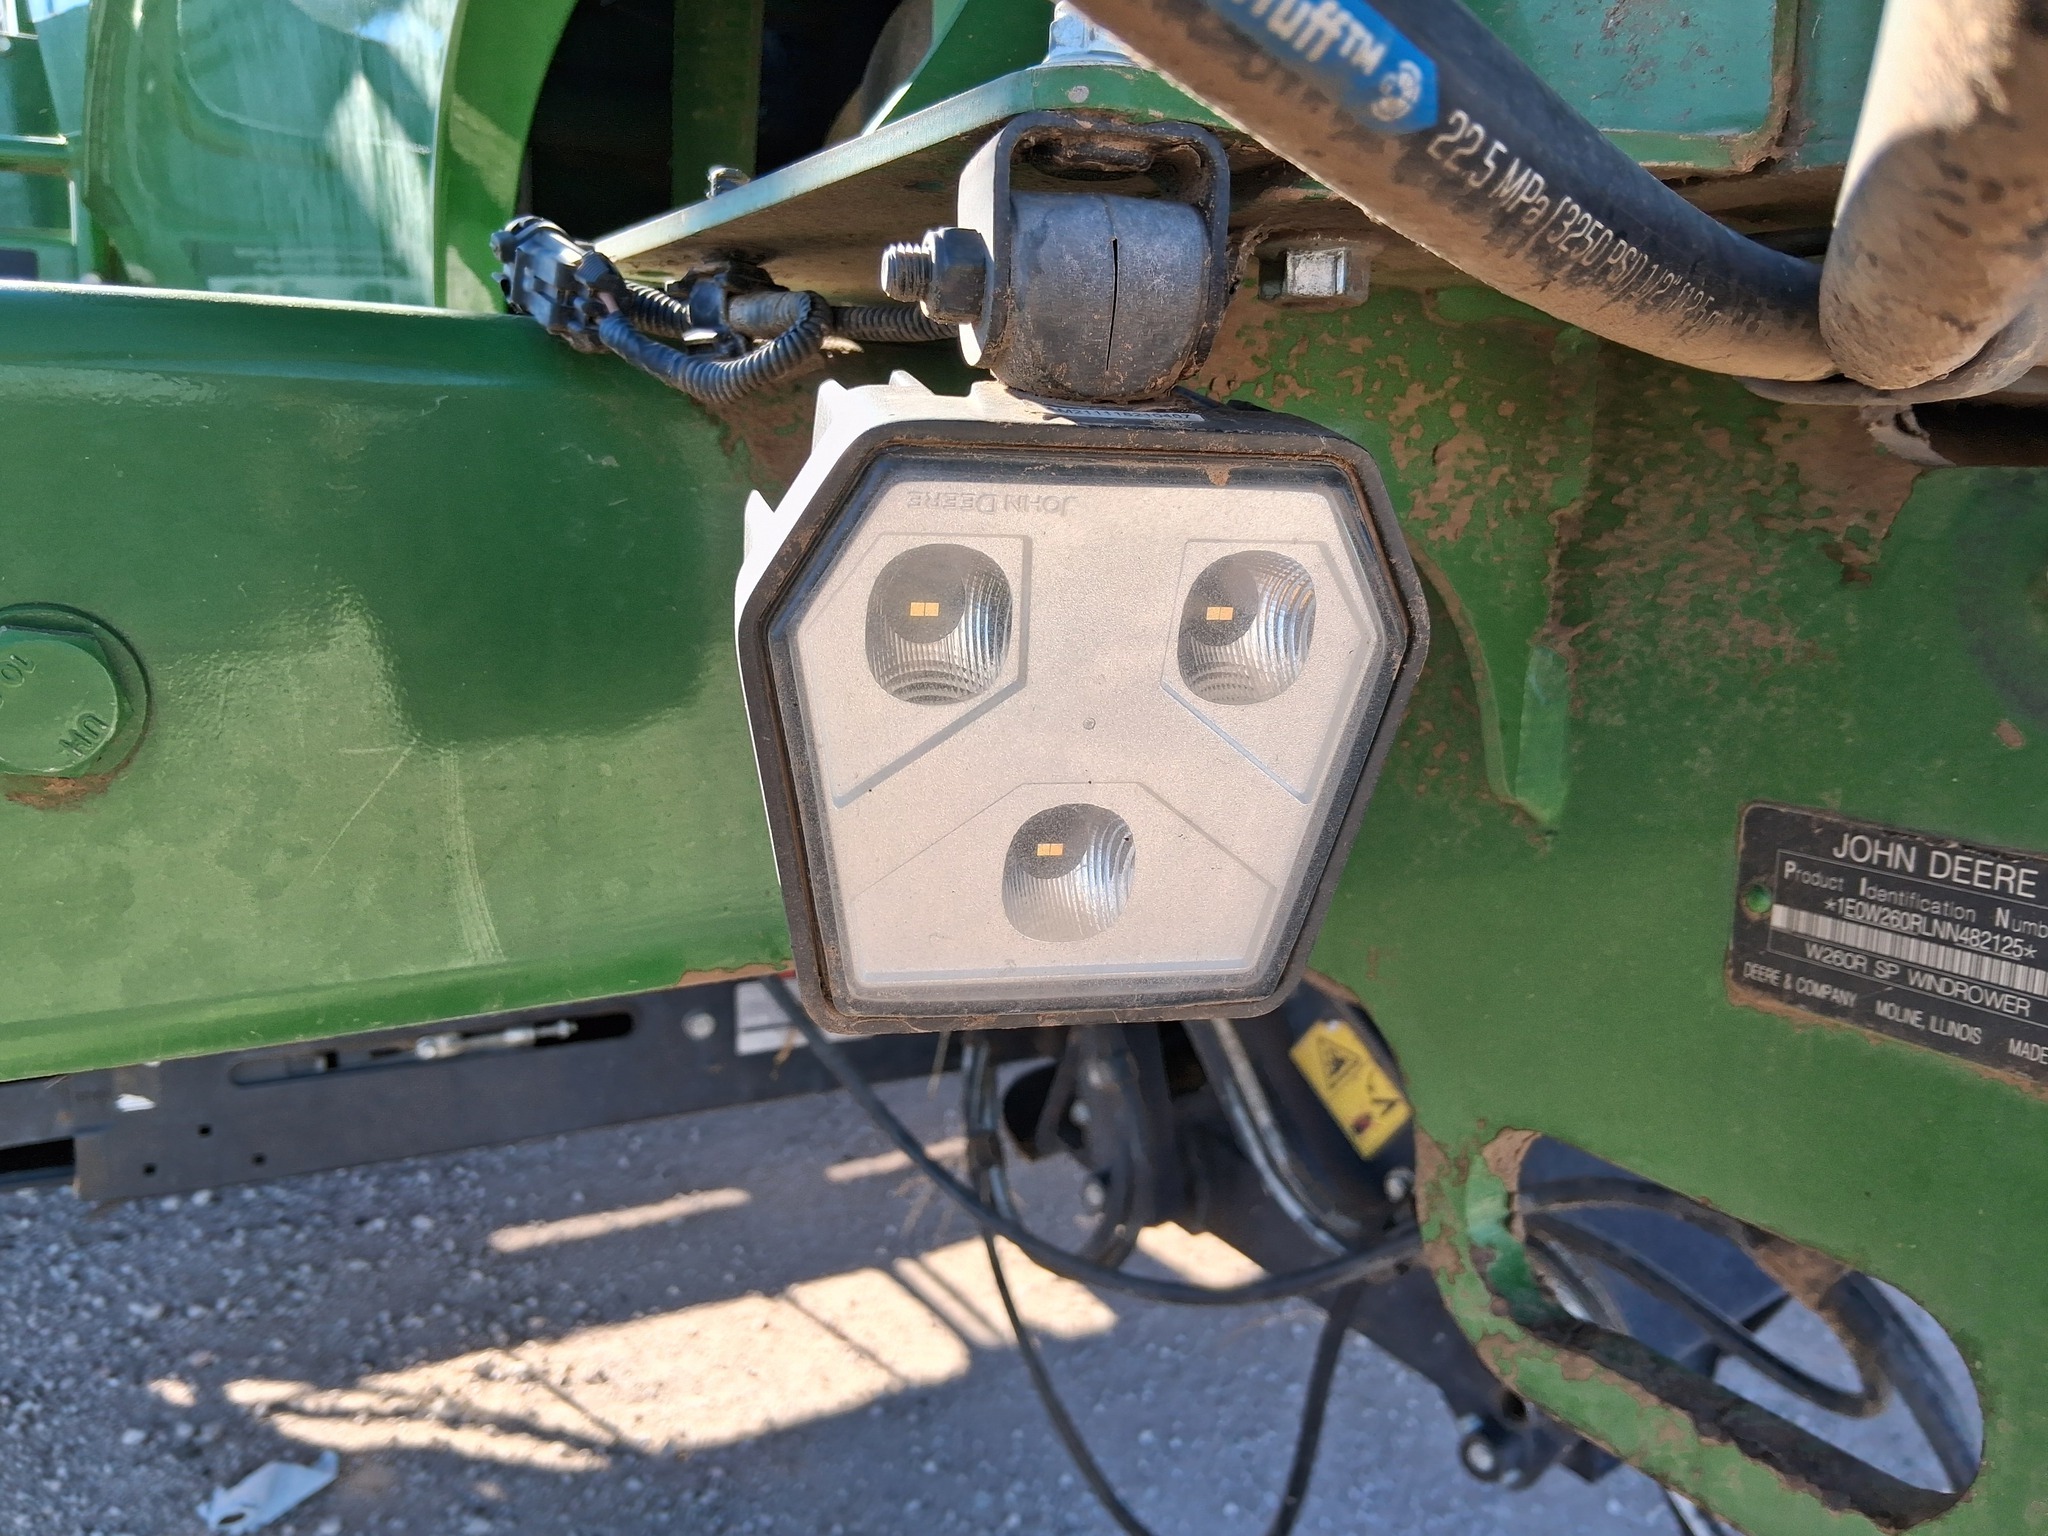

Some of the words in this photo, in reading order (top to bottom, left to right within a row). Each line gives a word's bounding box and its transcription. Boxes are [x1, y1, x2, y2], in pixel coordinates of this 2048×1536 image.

[1492, 157, 1551, 226] MPa
[907, 491, 996, 515] DEERE
[1004, 495, 1078, 516] JOHN
[1783, 860, 1845, 891] Product
[1859, 877, 1976, 922] Identification
[1833, 833, 1917, 873] JOHN
[1929, 850, 2039, 898] DEERE
[1804, 941, 1867, 974] W260R
[1874, 959, 1900, 979] SP
[1908, 968, 2031, 1018] WINDROWER
[1743, 961, 1781, 987] DEERE
[1783, 973, 1793, 990] &
[1795, 976, 1858, 1008] COMPANY
[1929, 1015, 1983, 1045] ILLINOIS
[2008, 1037, 2048, 1065] MADE
